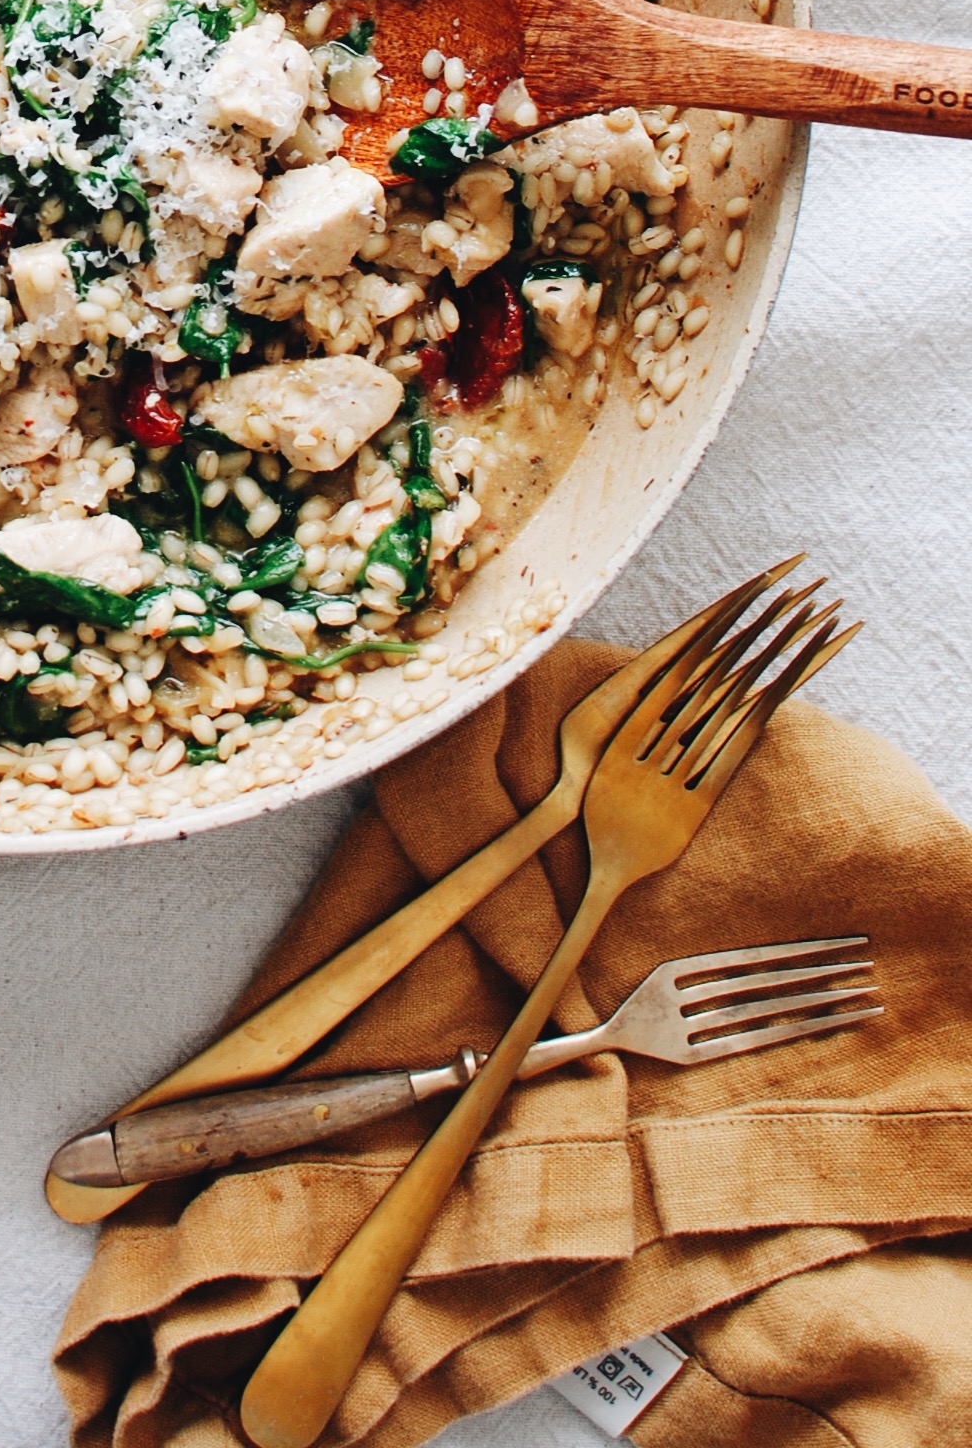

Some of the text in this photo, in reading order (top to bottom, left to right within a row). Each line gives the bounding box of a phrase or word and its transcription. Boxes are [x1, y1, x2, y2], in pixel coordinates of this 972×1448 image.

[629, 1352, 653, 1376] Made
[587, 1376, 599, 1390] %
[597, 1386, 617, 1405] 100
